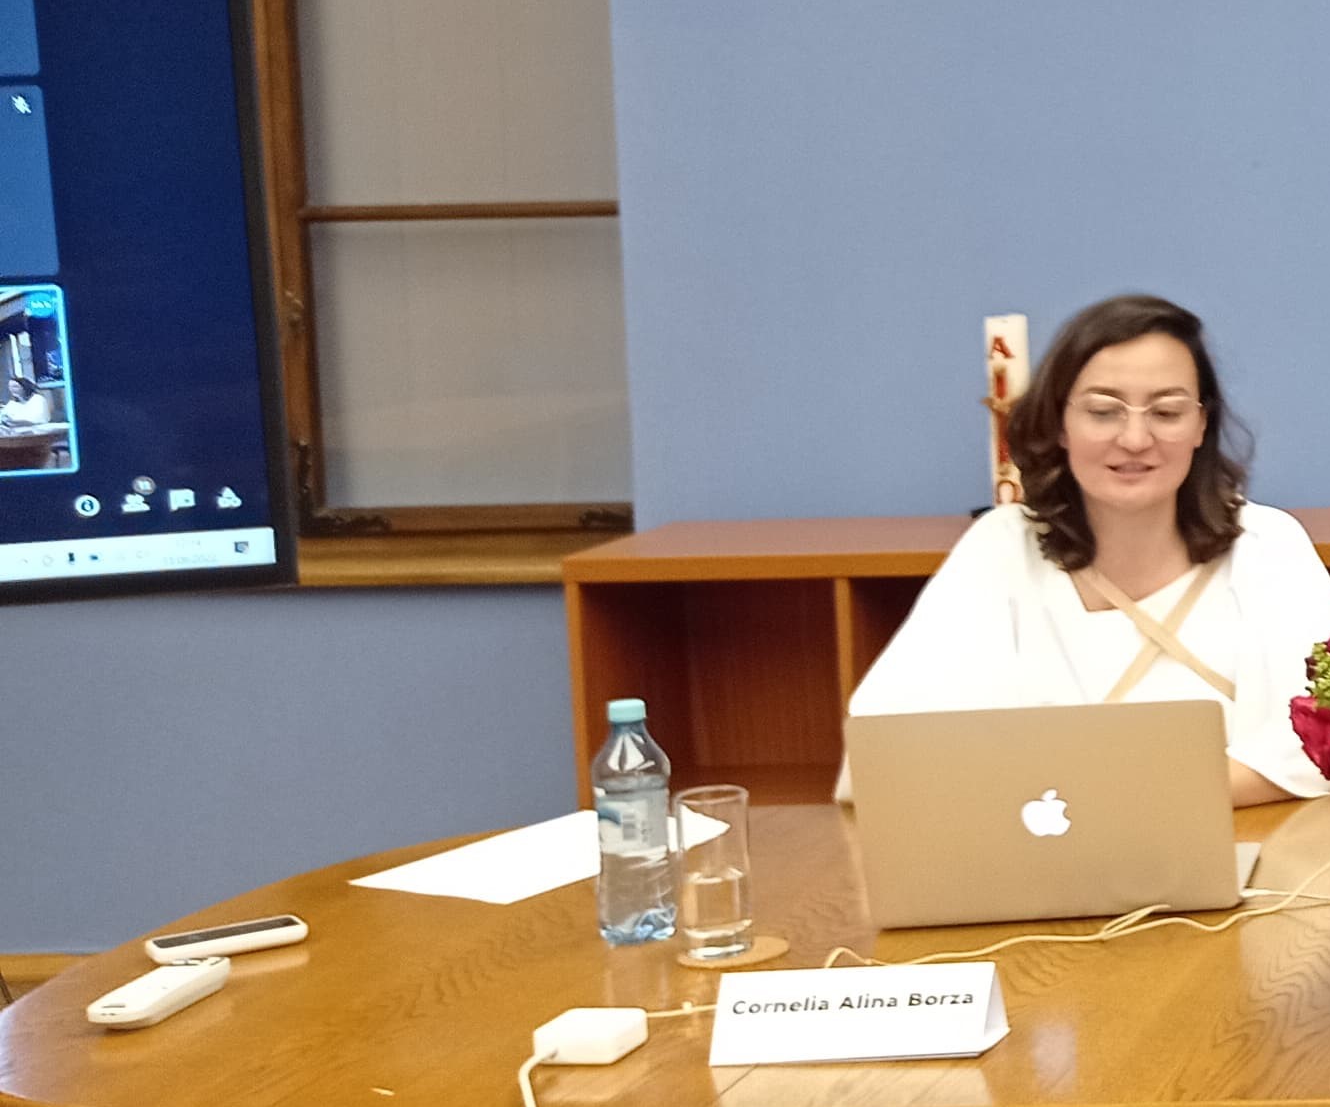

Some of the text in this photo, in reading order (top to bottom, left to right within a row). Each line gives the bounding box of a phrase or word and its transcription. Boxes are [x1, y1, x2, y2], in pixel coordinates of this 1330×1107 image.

[732, 992, 974, 1015] Cornelia Alina Borza
